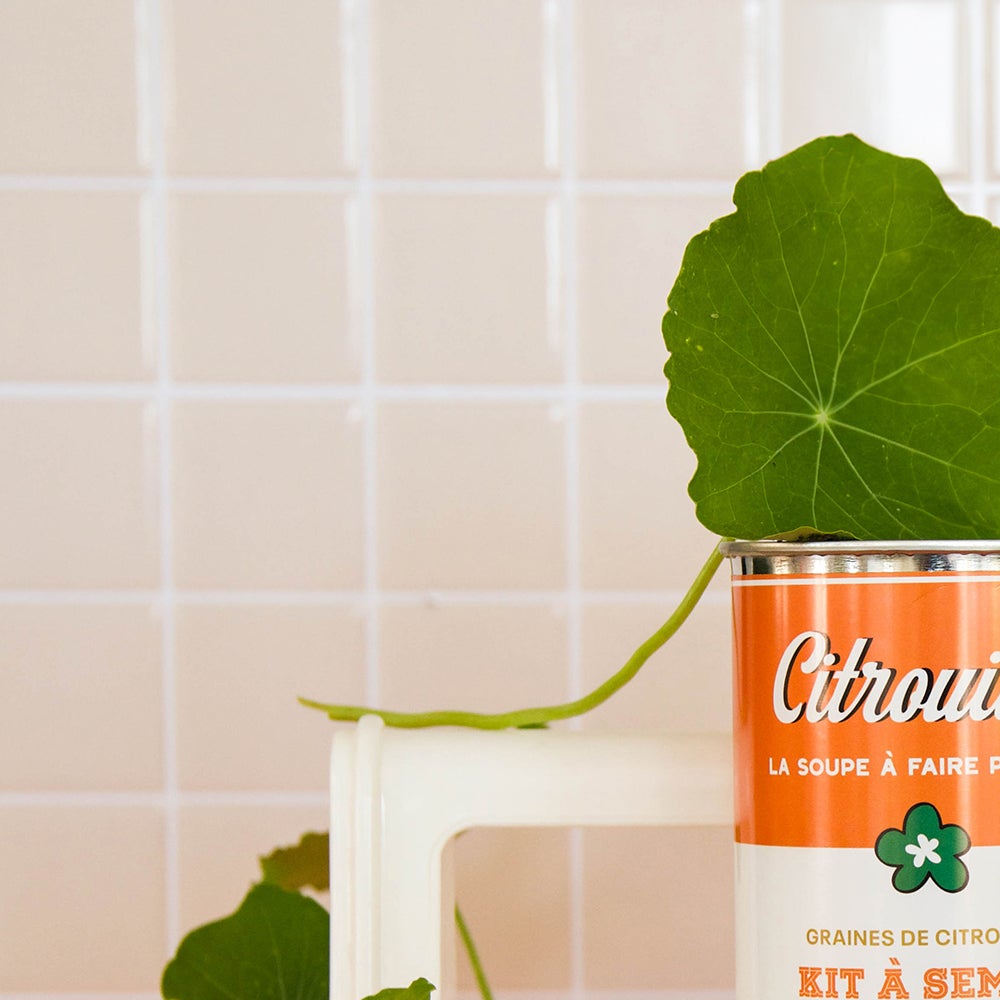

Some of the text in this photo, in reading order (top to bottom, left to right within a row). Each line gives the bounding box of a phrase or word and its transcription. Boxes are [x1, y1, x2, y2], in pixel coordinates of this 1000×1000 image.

[769, 757, 790, 777] LA
[798, 757, 869, 777] SOUPE
[880, 750, 897, 777] À
[908, 756, 979, 776] FAIRE
[806, 928, 895, 947] GRAINES
[901, 929, 929, 947] DE
[798, 966, 865, 999] KIT
[877, 957, 910, 1000] À
